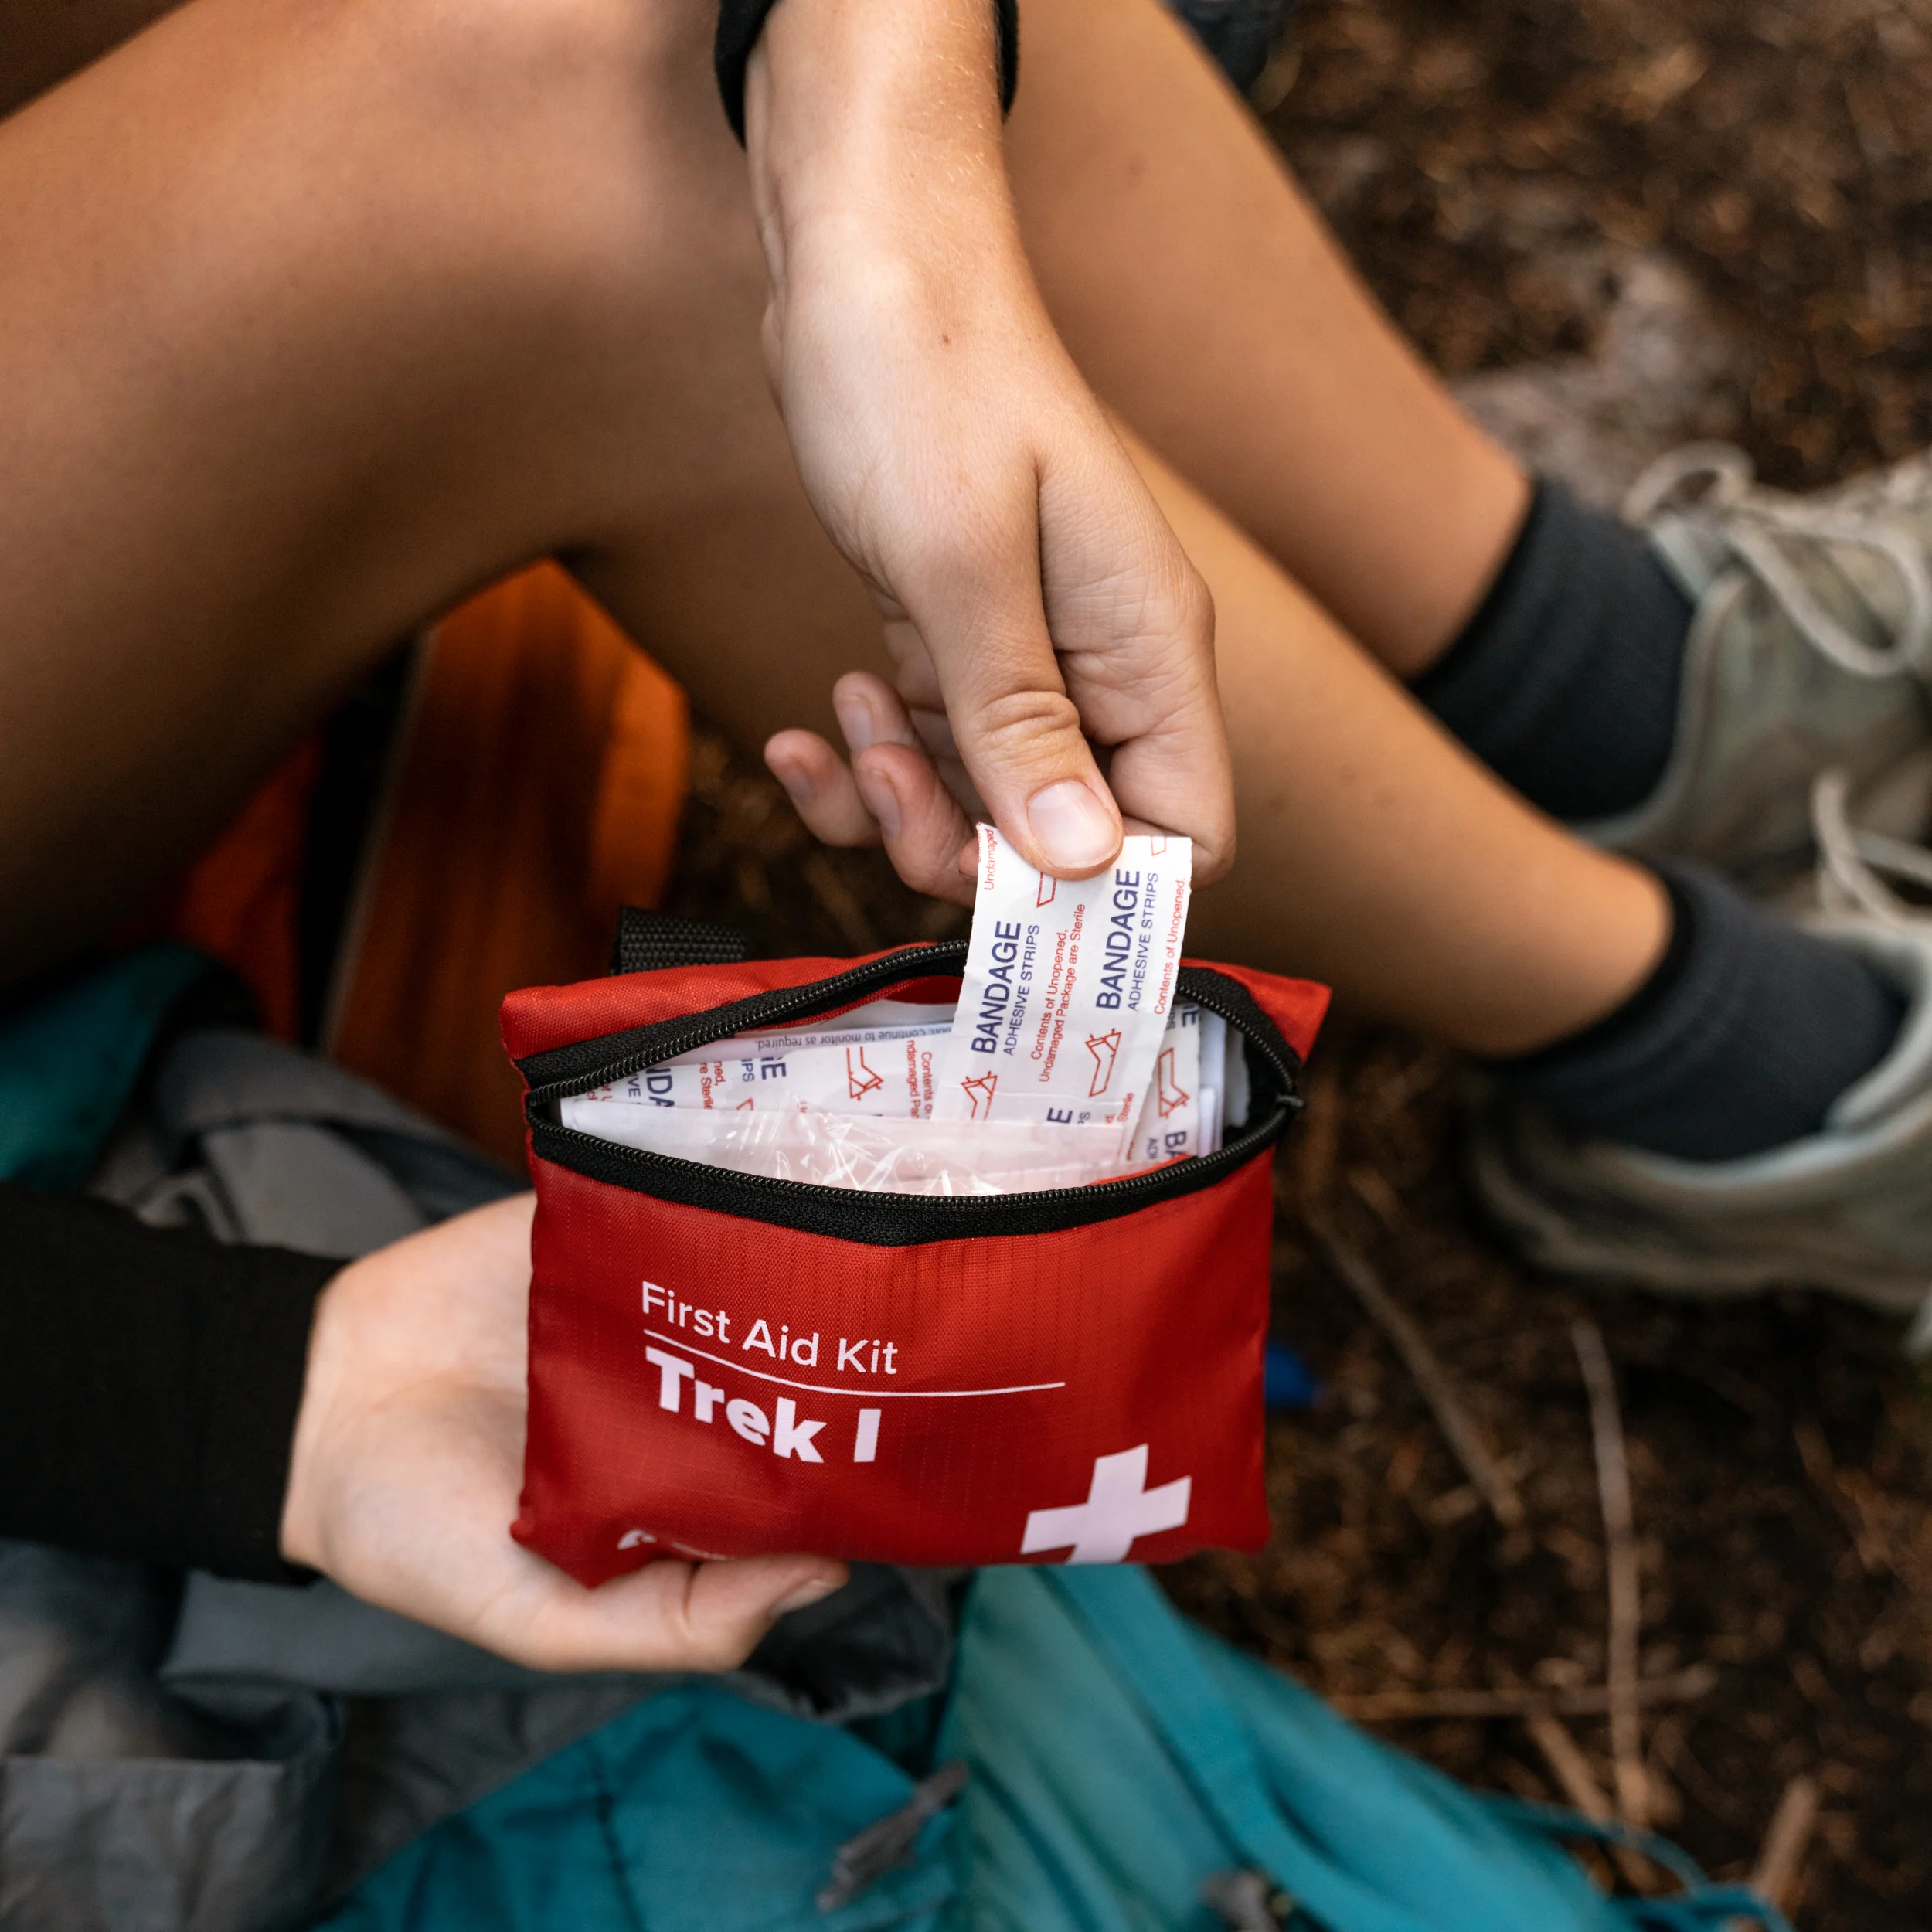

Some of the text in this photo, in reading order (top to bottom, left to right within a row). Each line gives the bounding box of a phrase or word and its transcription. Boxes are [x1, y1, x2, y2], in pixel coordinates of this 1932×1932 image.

[984, 828, 997, 890] Undamaged
[1096, 869, 1140, 1010] BANDAGE
[1128, 872, 1158, 1011] ADHESIVE STRIPS
[1155, 961, 1173, 1015] Contents
[1166, 945, 1175, 958] of
[971, 921, 1021, 1054] BANDAGE
[1003, 925, 1039, 1056] ADHESIVE STRIPS
[1032, 930, 1068, 1060] Contents of Unopened,
[1039, 904, 1087, 1082] Undamaged Package are Sterile
[755, 1038, 803, 1051] required.
[819, 1032, 862, 1043] monitor
[865, 1031, 875, 1040] to
[906, 1040, 920, 1097] ndamaged
[921, 1052, 933, 1101] Contents
[641, 1281, 898, 1375] First Aid Kit
[645, 1346, 882, 1464] Trek I
